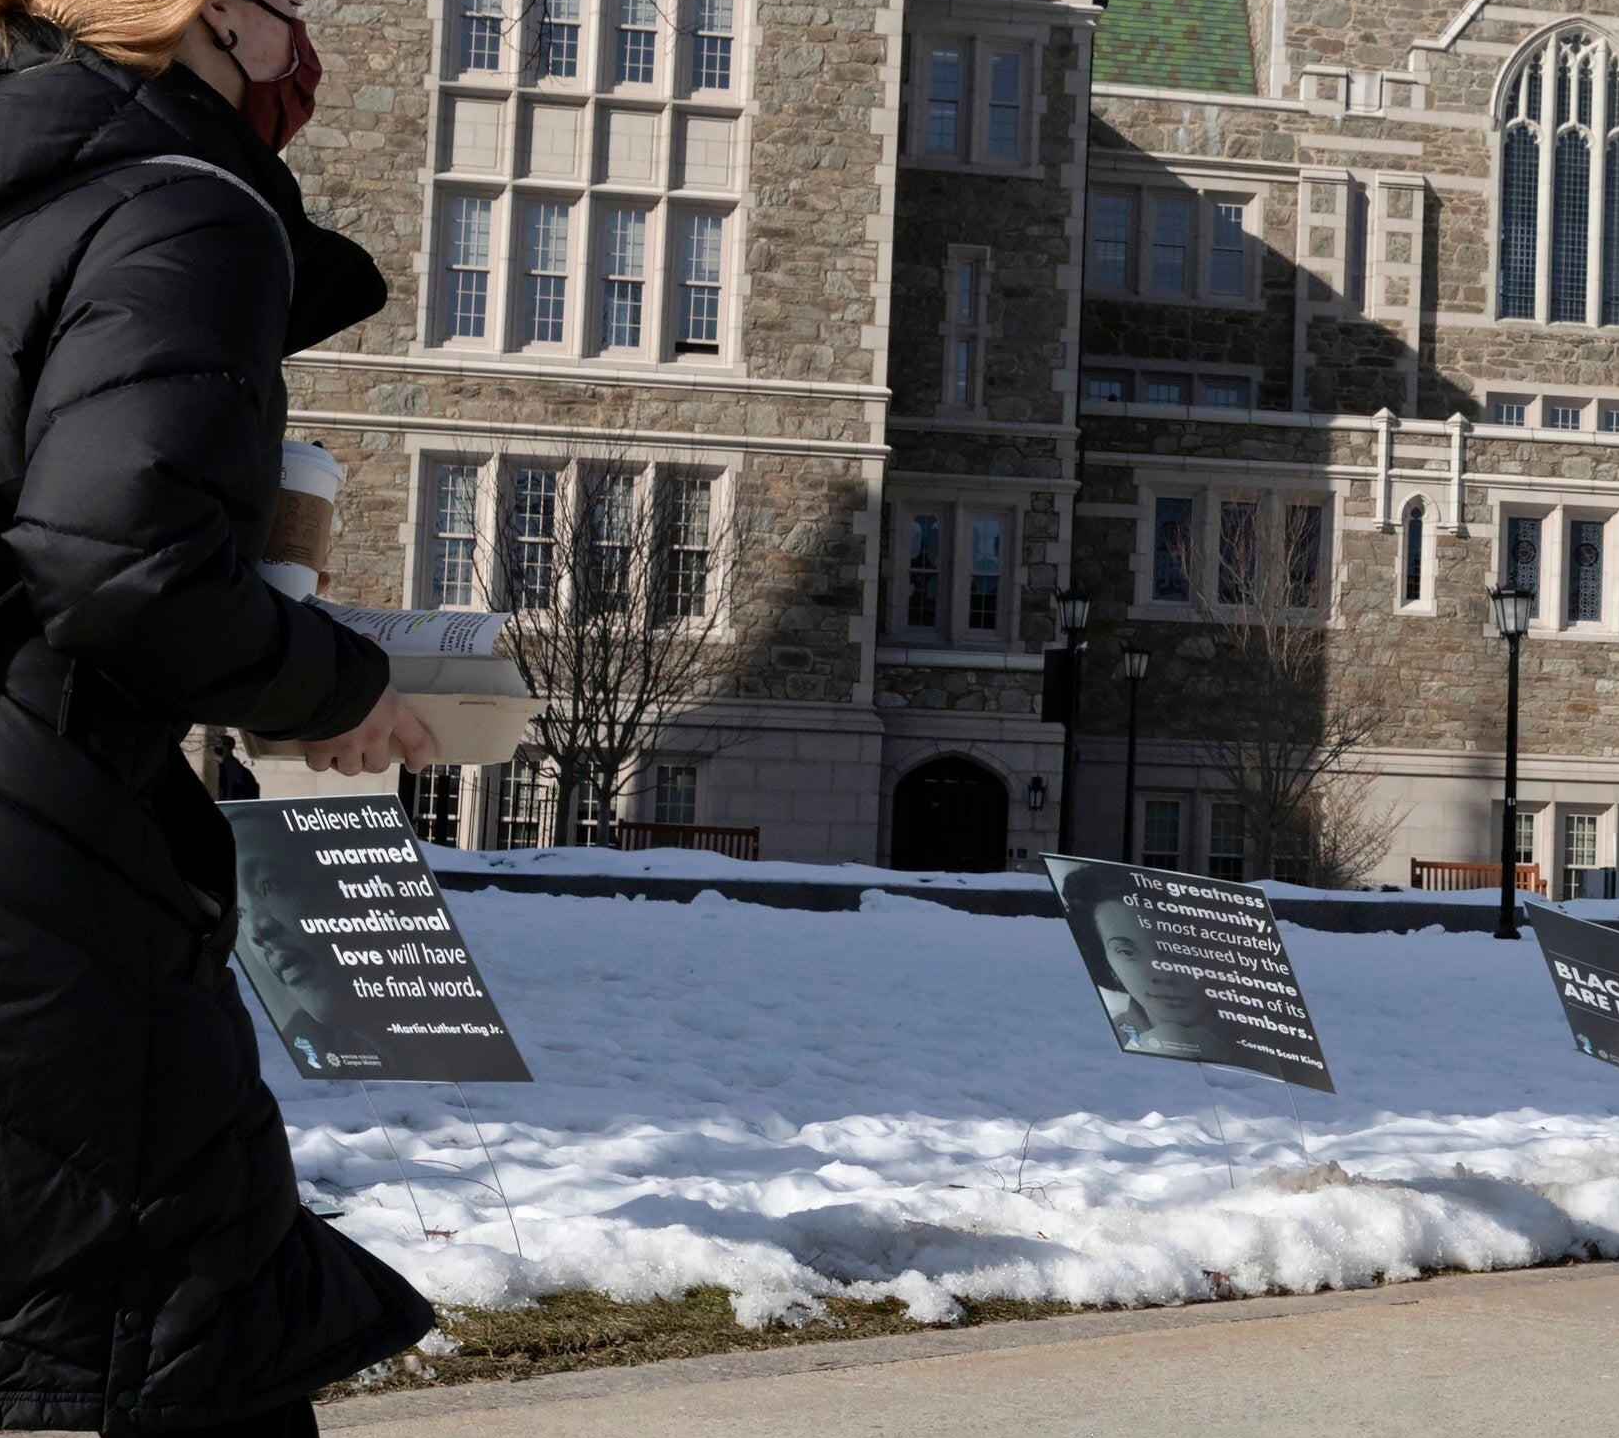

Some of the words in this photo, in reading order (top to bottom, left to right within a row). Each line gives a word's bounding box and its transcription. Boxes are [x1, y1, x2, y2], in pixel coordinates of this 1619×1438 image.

[282, 809, 294, 832] I
[292, 807, 361, 831] believe
[361, 805, 402, 828] that
[315, 839, 417, 865] unarmed
[338, 875, 394, 898] truth
[397, 874, 434, 897] and
[1130, 872, 1163, 890] The
[1166, 881, 1265, 908] greatness
[299, 908, 450, 933] unconditional
[1122, 893, 1140, 907] of
[1142, 898, 1154, 910] a
[1156, 900, 1272, 933] community,
[1137, 914, 1153, 930] is
[1156, 920, 1197, 937] most
[1200, 927, 1281, 955] accurately
[331, 943, 383, 965] love
[386, 943, 420, 964] will
[421, 943, 466, 964] have
[1155, 939, 1235, 964] measured
[1237, 951, 1258, 972] by
[1260, 957, 1289, 976] the
[352, 976, 384, 998] the
[386, 975, 426, 997] final
[428, 975, 483, 997] word.
[1150, 959, 1297, 997] compassionate
[1204, 986, 1263, 1009] action
[1266, 999, 1286, 1013] of
[1285, 1001, 1307, 1019] its
[1564, 982, 1612, 1011] ARE
[429, 1022, 461, 1034] Luther
[462, 1023, 489, 1036] King
[489, 1023, 504, 1035] Jr.
[1217, 1008, 1313, 1041] members.
[1276, 1048, 1299, 1062] Scott
[1300, 1054, 1323, 1069] King
